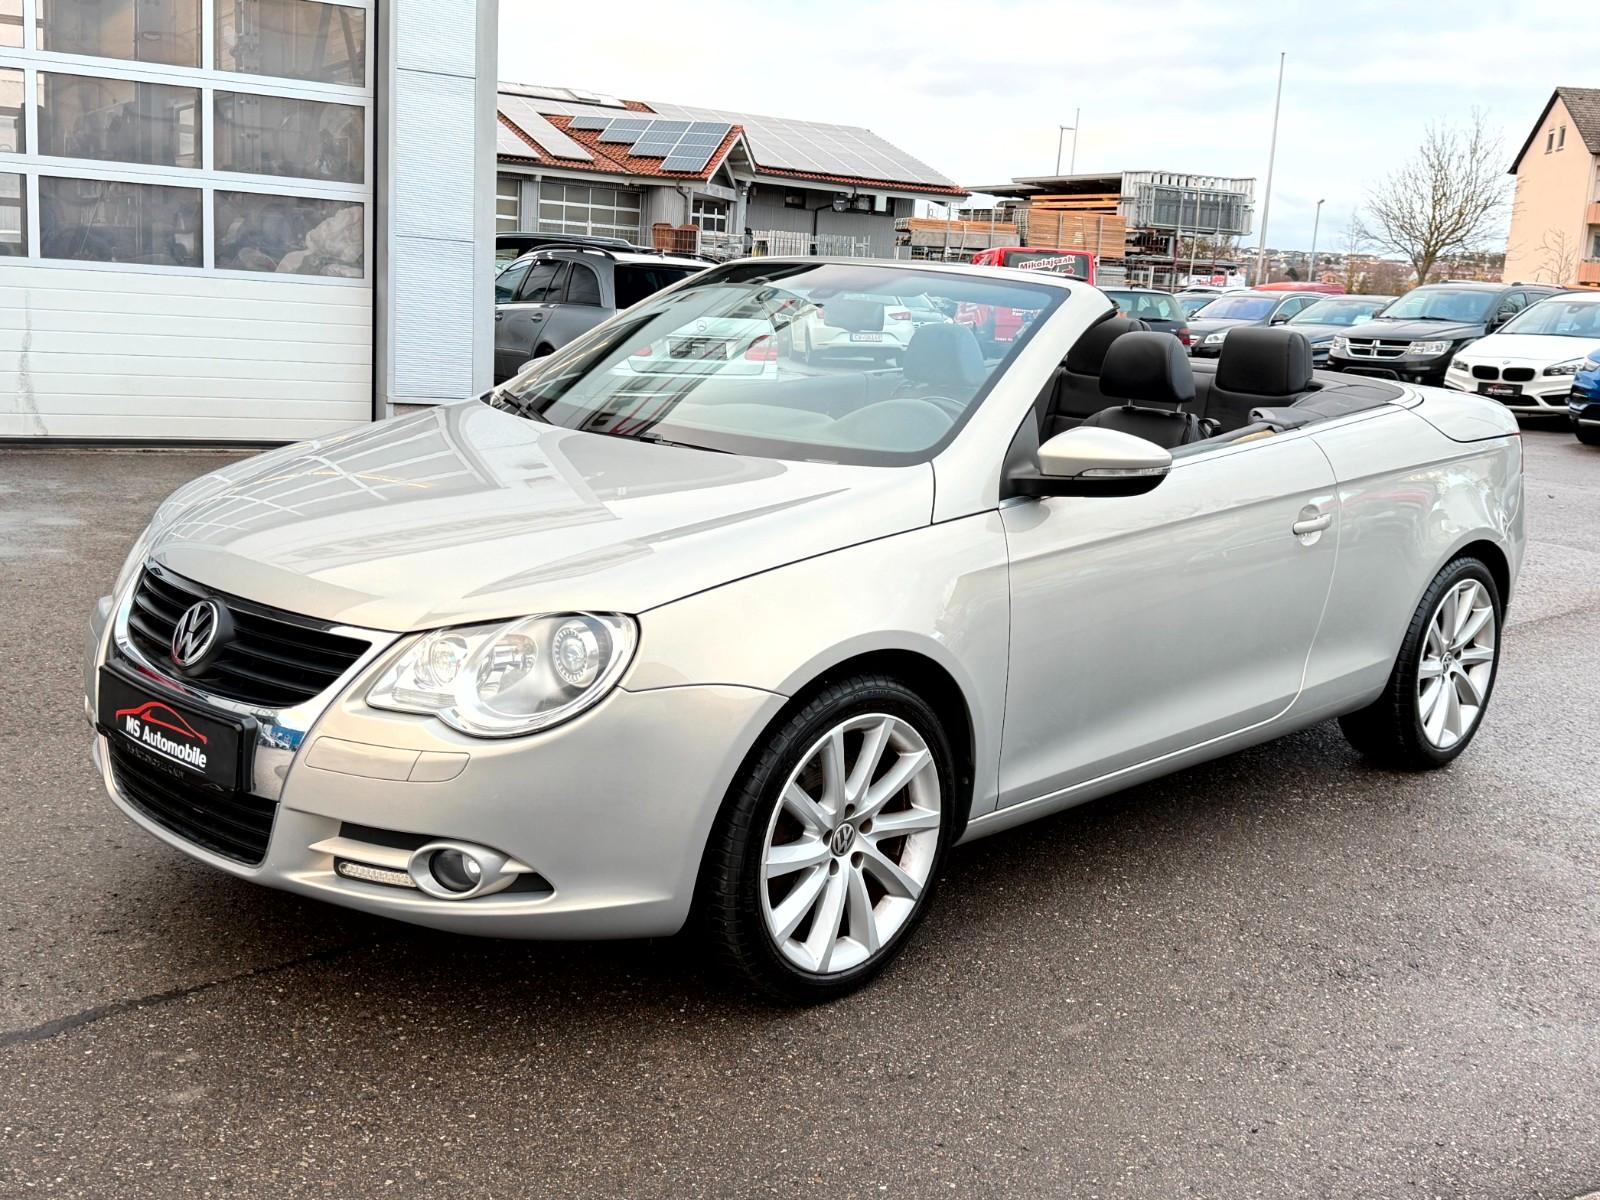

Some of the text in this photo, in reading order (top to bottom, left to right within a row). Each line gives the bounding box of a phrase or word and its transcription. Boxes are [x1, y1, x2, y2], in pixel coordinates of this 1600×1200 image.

[173, 601, 218, 666] VW
[126, 715, 140, 737] MS
[142, 726, 207, 768] Automobile
